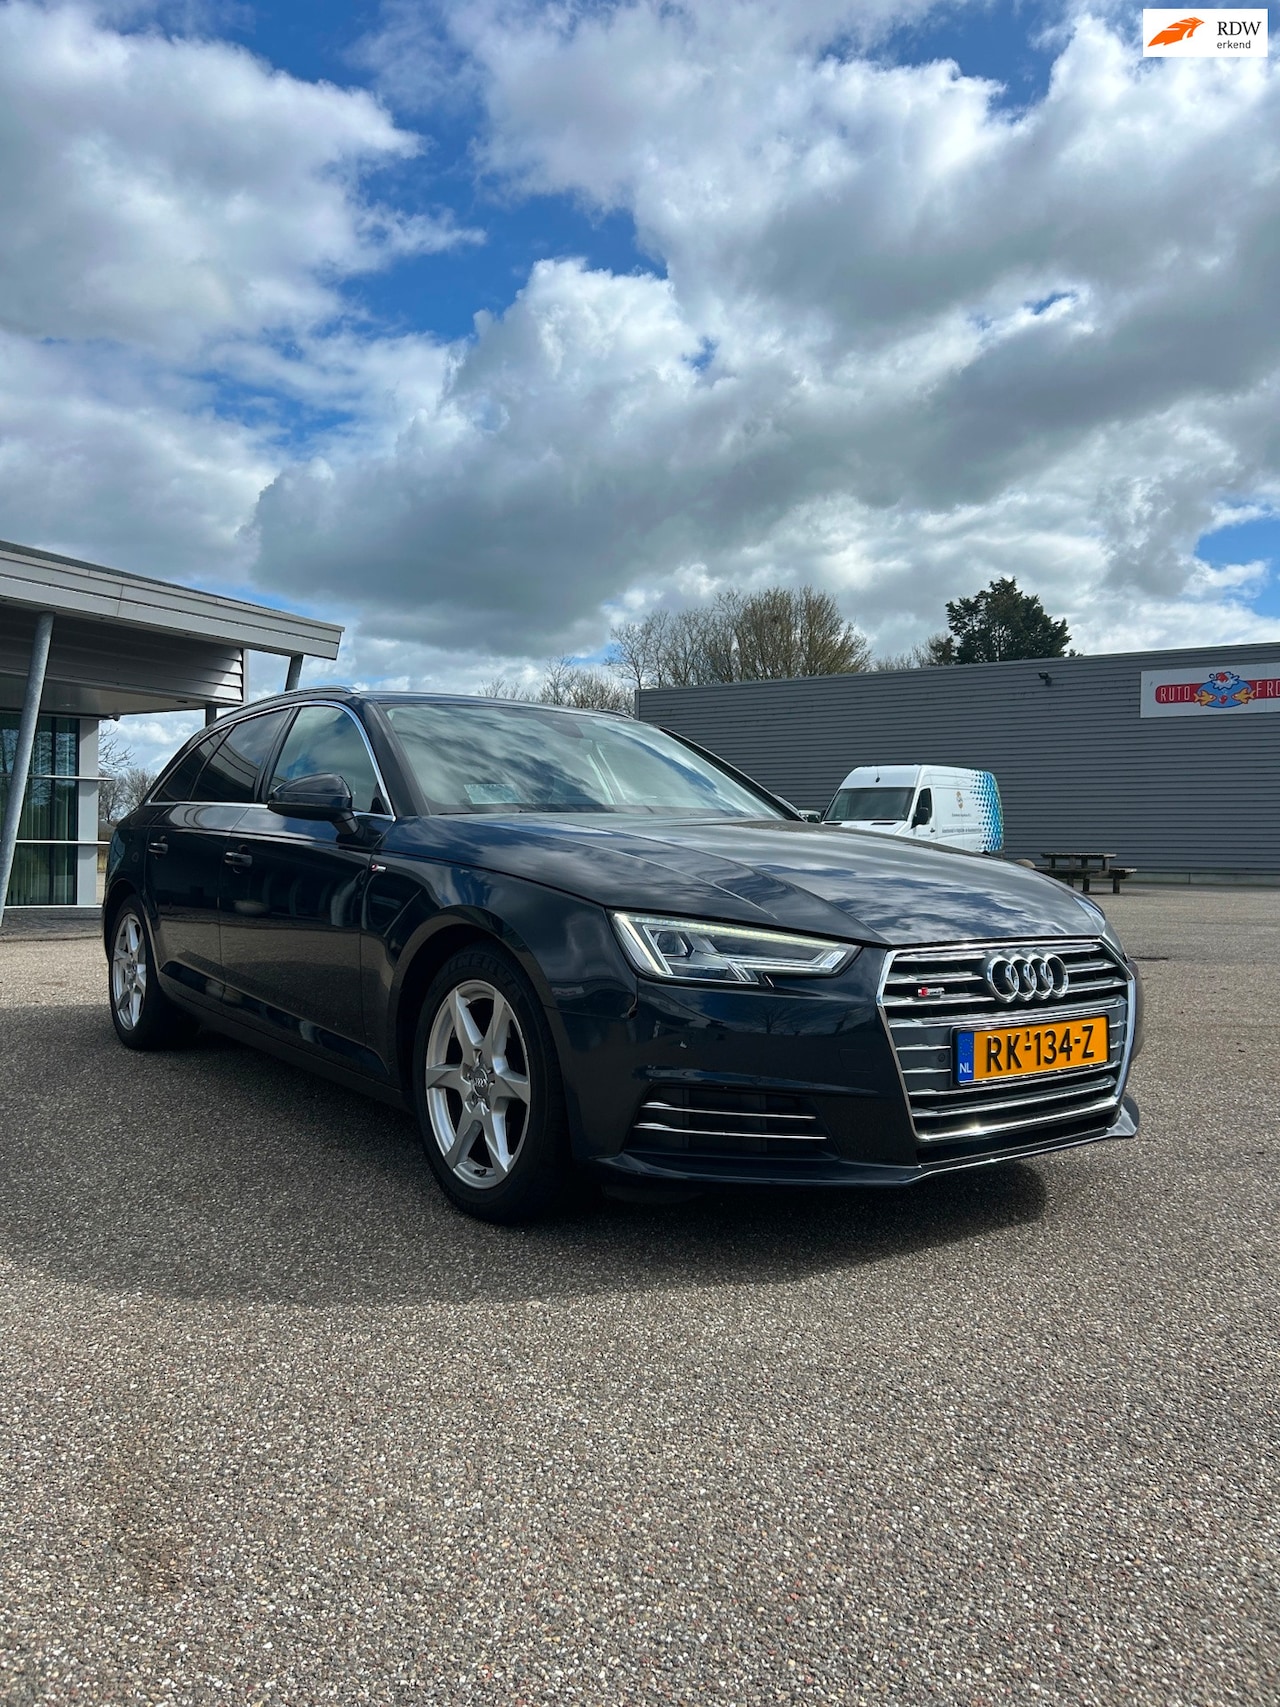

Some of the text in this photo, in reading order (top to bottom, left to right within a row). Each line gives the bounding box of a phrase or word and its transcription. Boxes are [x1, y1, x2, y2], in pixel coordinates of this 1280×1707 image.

[1160, 686, 1190, 702] RUTO
[986, 1024, 1095, 1073] RK-134-Z
[959, 1061, 972, 1074] NL
